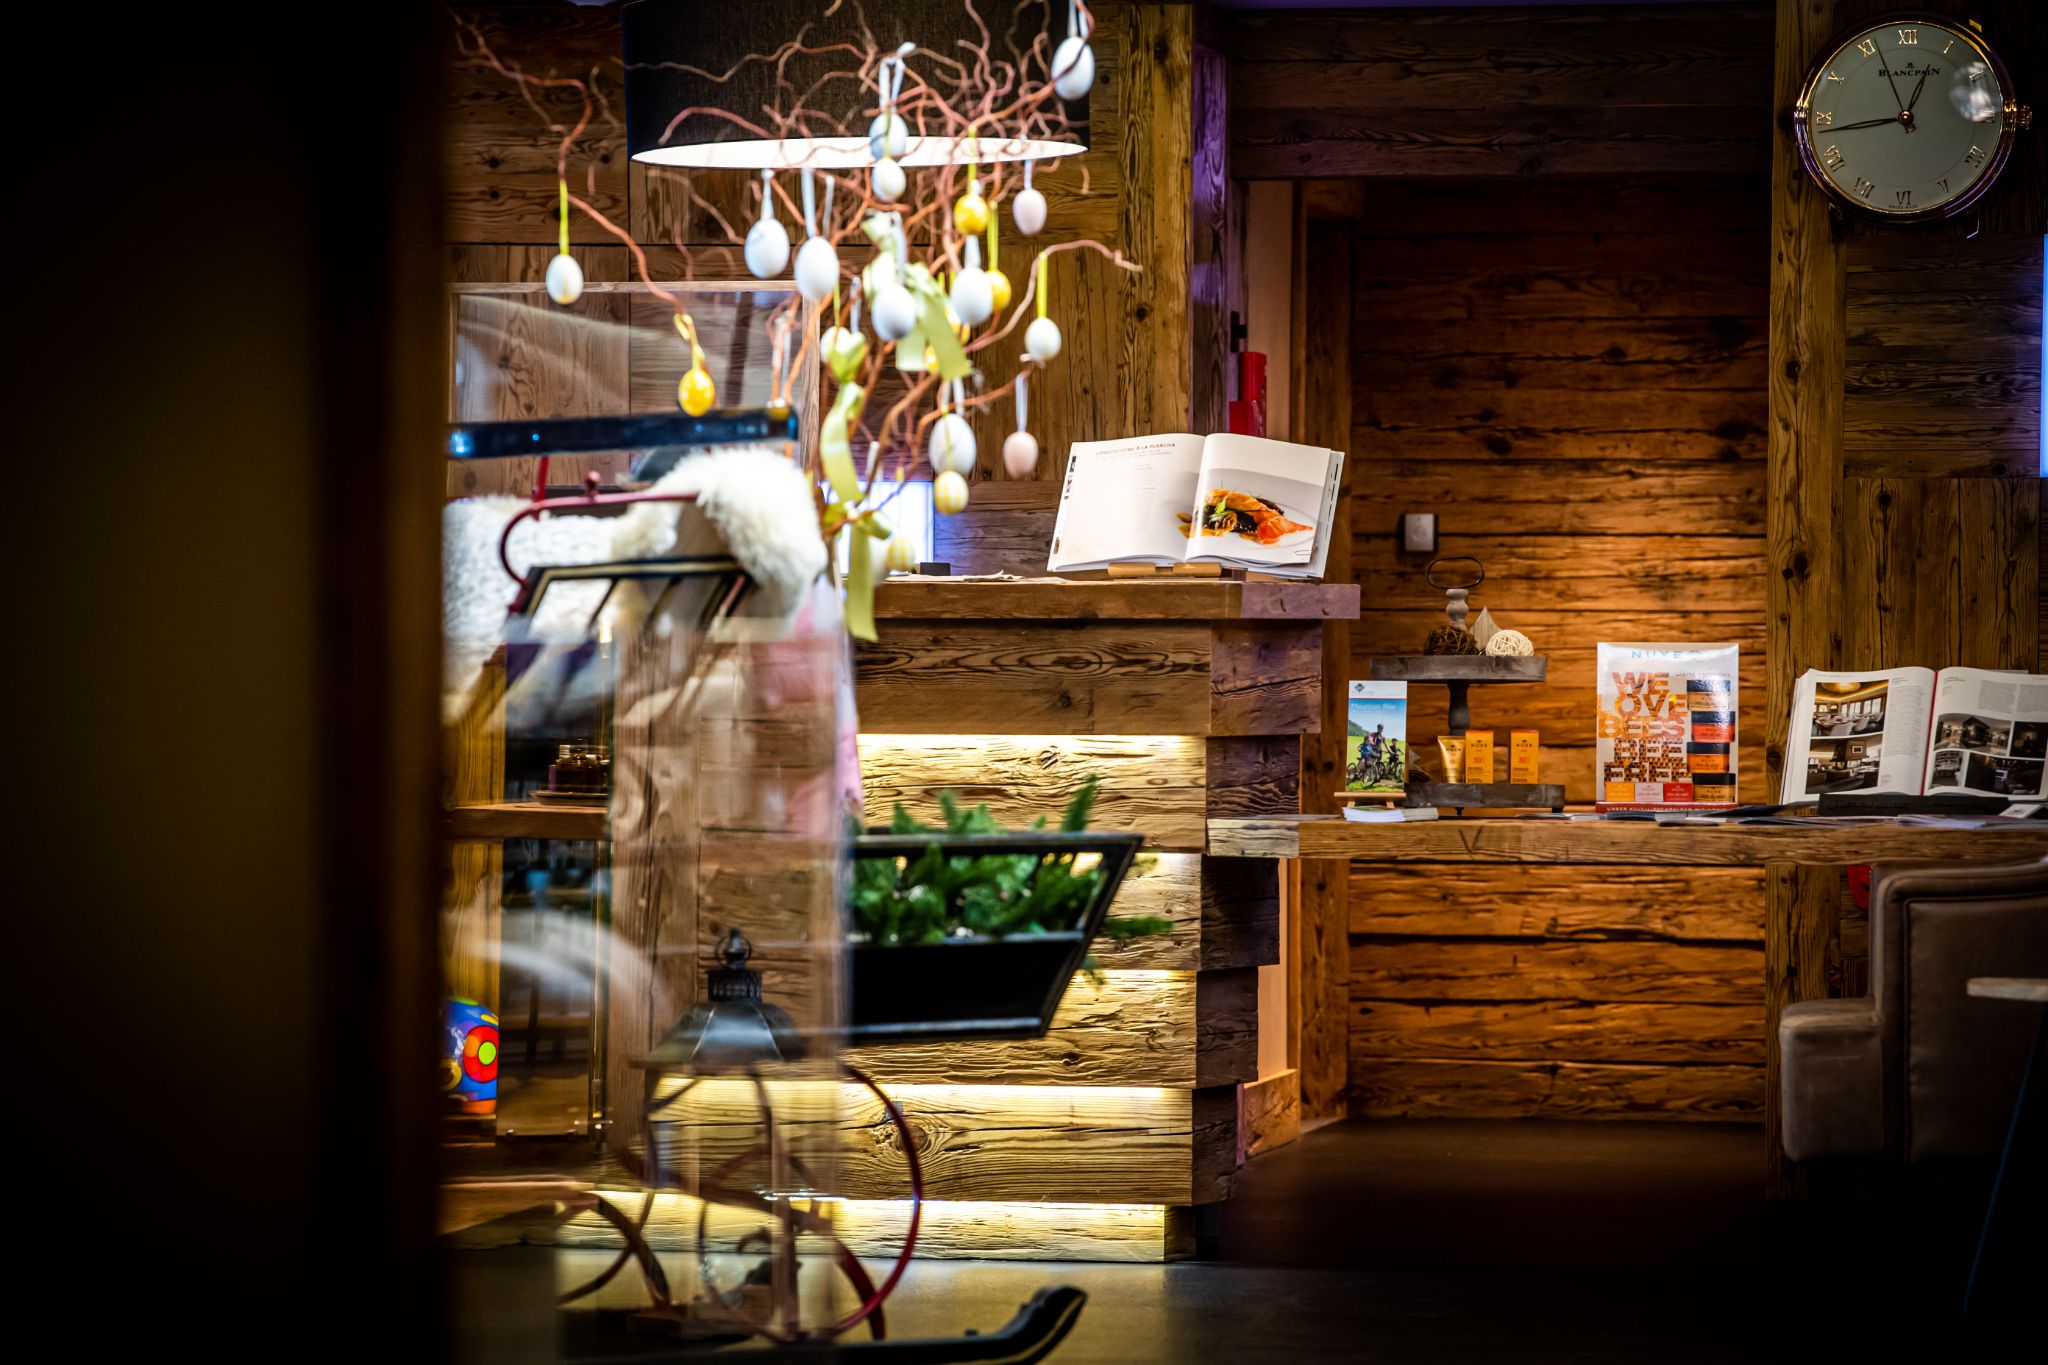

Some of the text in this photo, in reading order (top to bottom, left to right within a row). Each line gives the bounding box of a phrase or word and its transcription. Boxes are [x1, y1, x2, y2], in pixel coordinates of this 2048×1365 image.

[1898, 29, 1918, 45] XII
[1857, 38, 1876, 58] XI
[1828, 71, 1844, 84] X
[1878, 68, 1940, 77] BLANCPAIN
[1816, 111, 1832, 127] IX
[1824, 145, 1846, 172] VIII
[1854, 177, 1875, 199] VII
[1937, 179, 1949, 193] V
[1896, 190, 1911, 205] VI
[1612, 672, 1670, 695] WE
[1598, 714, 1685, 738] BEES
[1614, 738, 1683, 761] BEE
